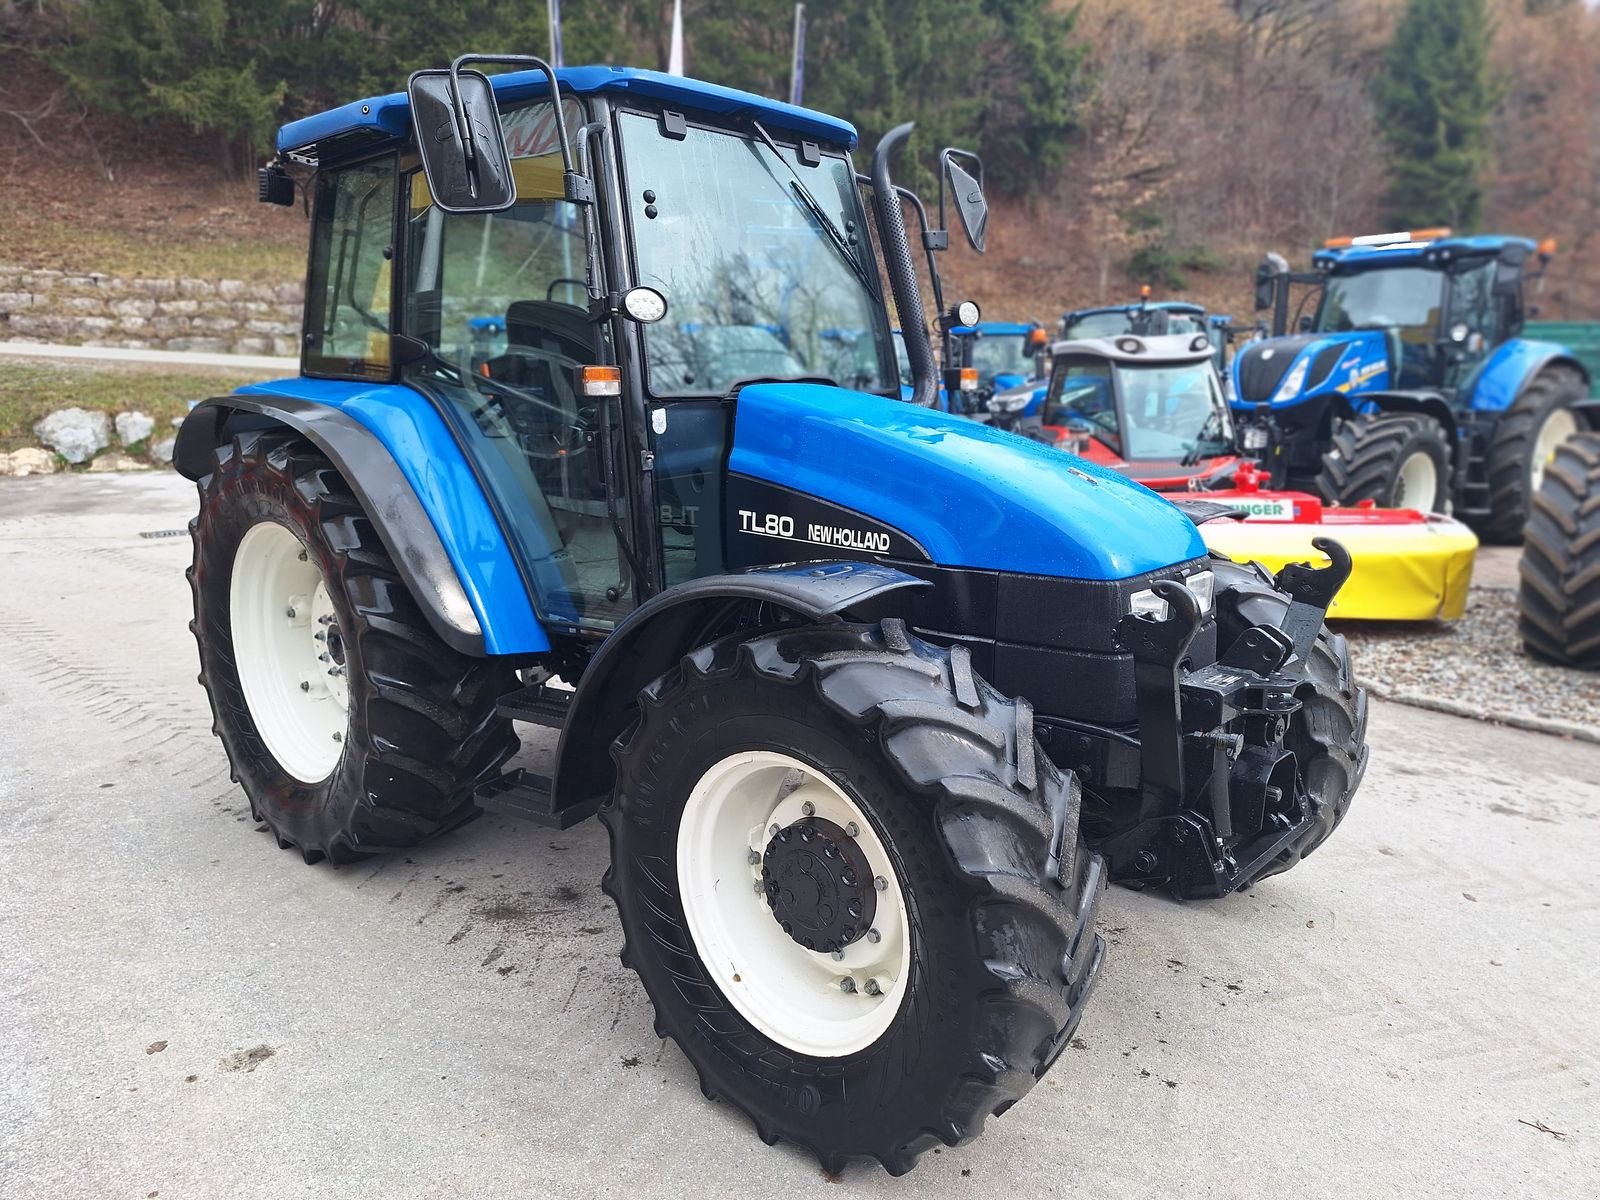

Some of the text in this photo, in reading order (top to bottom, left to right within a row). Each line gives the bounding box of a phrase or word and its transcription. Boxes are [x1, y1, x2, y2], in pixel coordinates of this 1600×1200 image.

[738, 509, 794, 537] TL80
[1232, 504, 1283, 515] INGER
[808, 523, 890, 551] NEW HOLLAND
